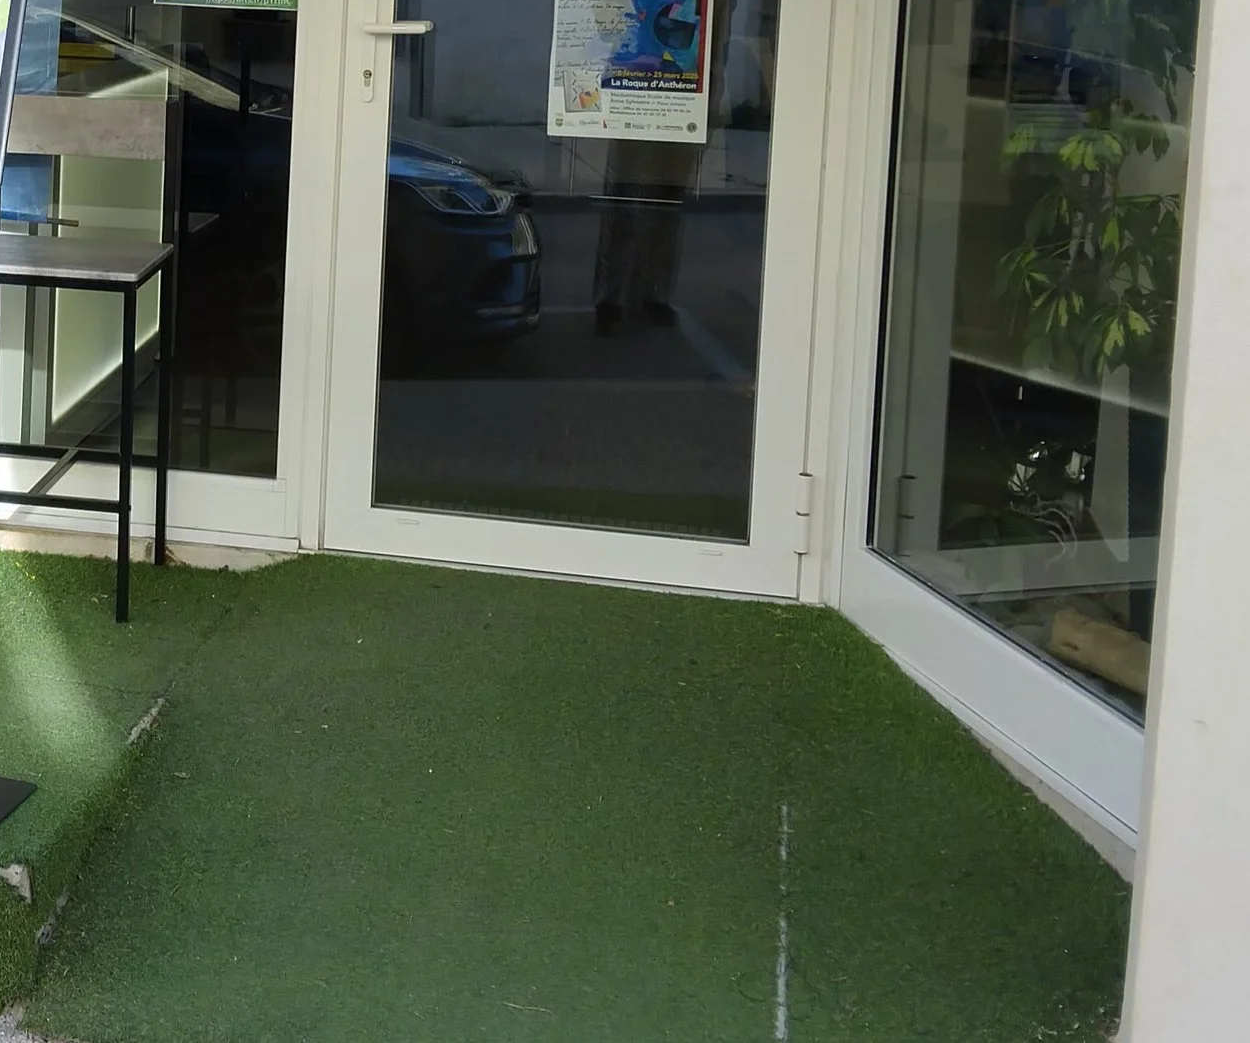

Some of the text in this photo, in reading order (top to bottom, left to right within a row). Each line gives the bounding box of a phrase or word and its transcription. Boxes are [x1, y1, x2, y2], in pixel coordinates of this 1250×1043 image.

[611, 78, 696, 89] La Roque d'Anthéron
